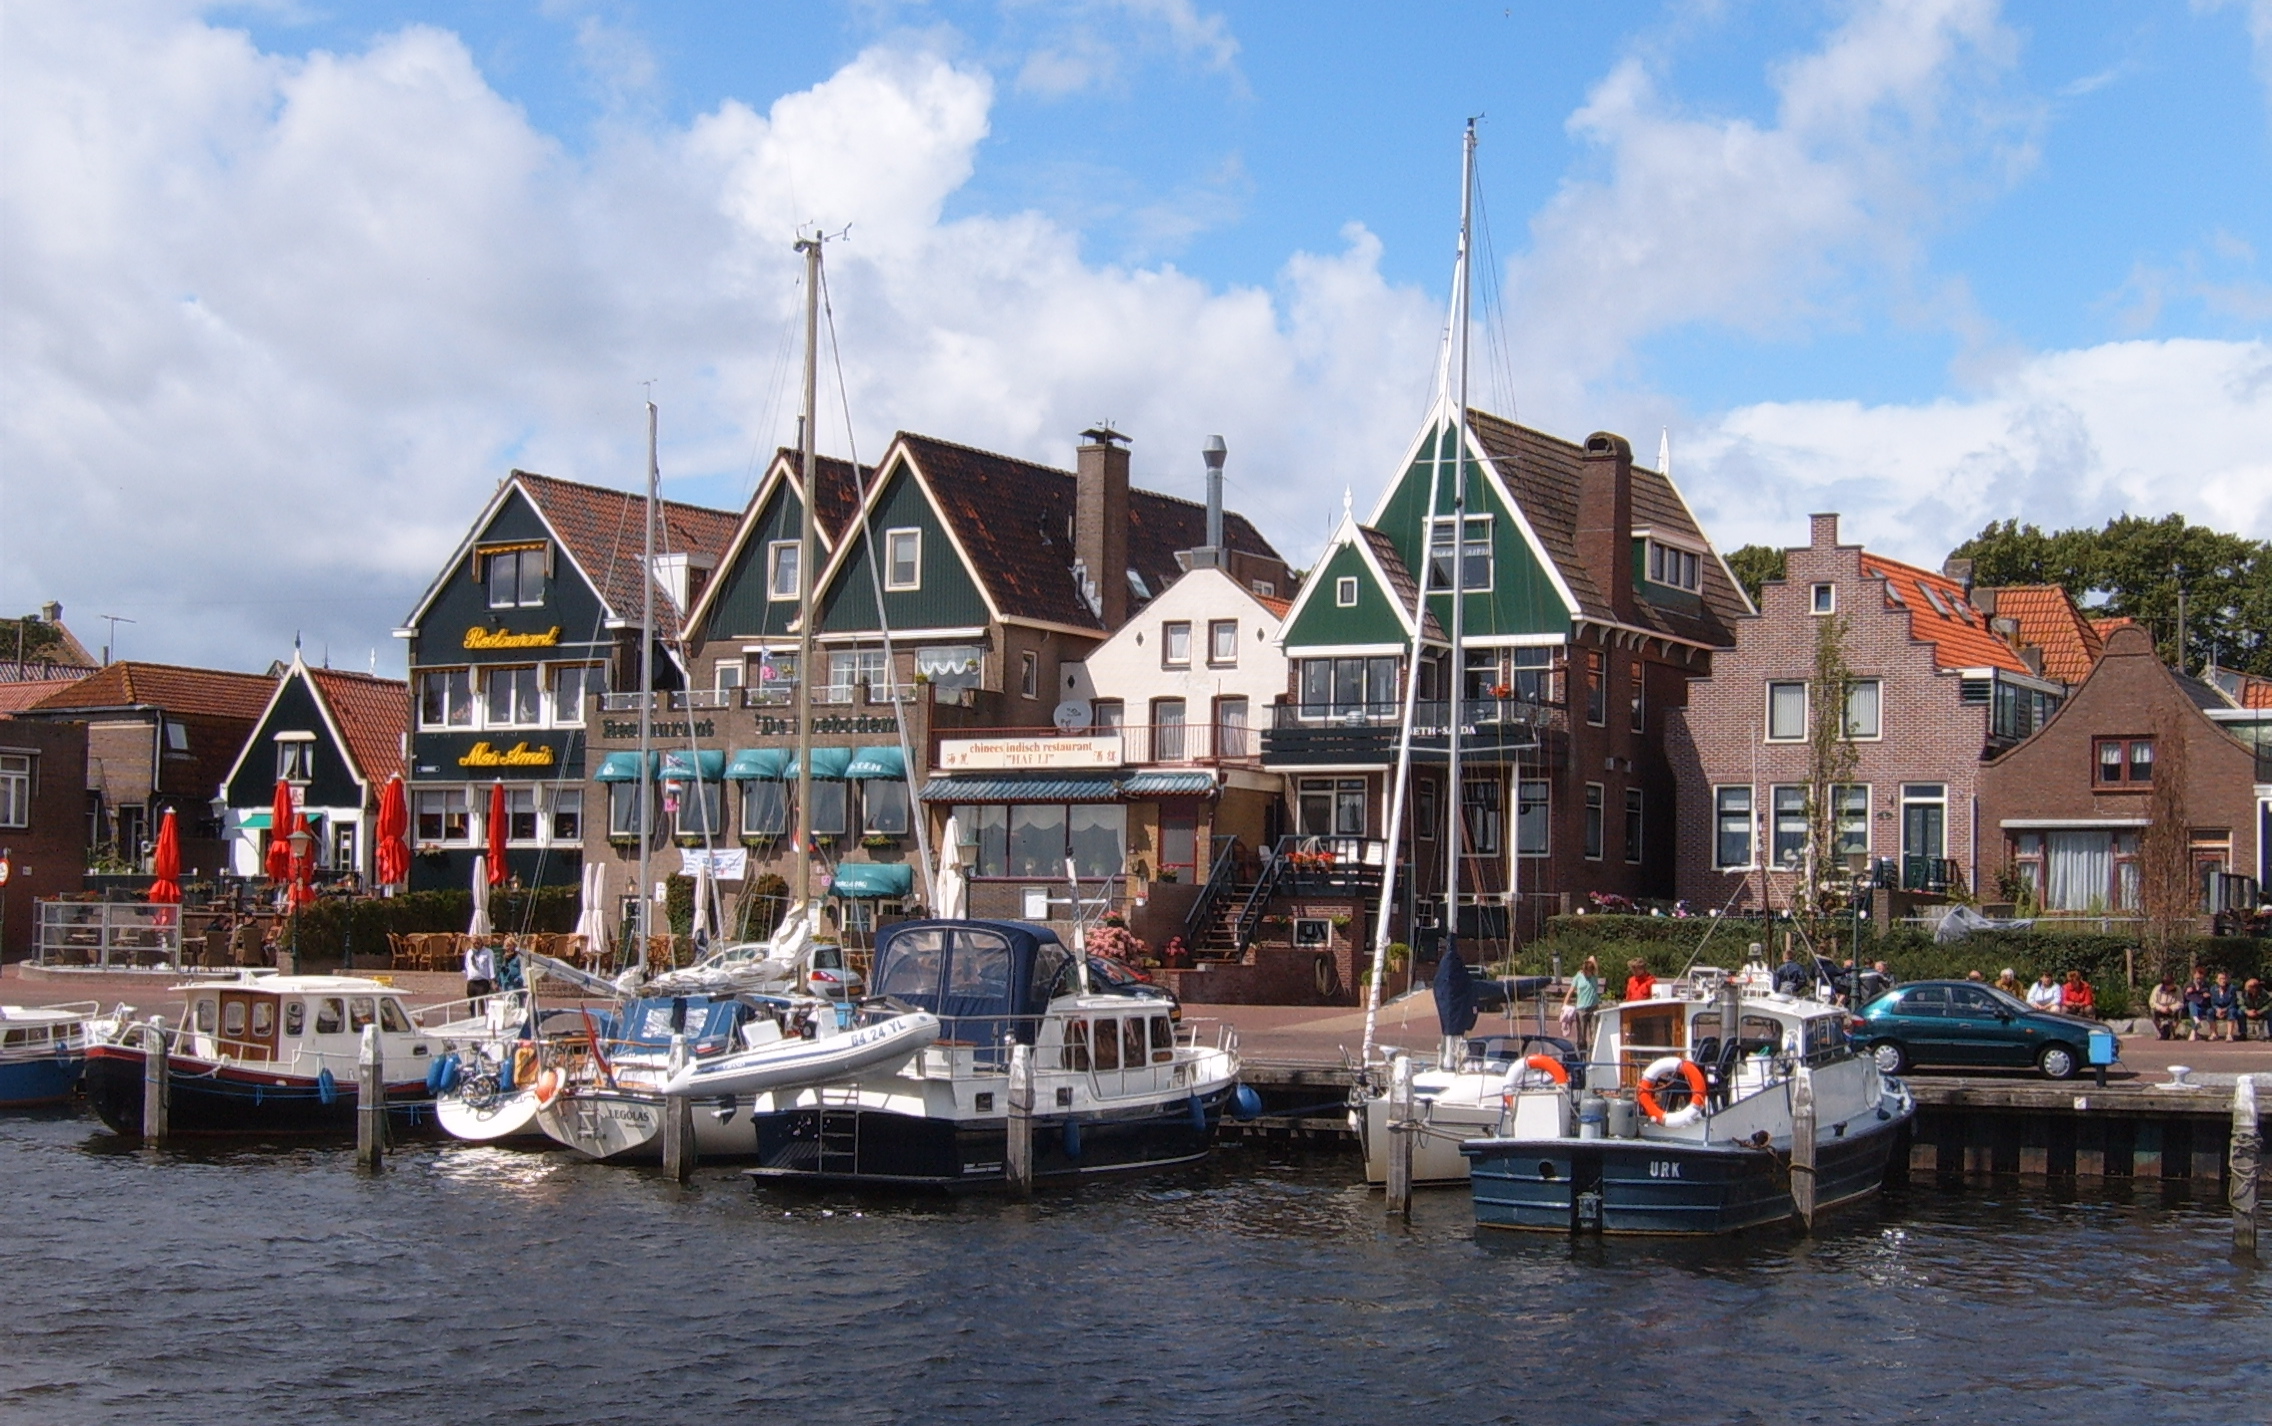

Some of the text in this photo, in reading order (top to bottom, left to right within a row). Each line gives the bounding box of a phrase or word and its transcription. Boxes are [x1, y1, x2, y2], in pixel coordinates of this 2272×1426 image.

[970, 741, 1093, 754] chinees indisch restaurant
[609, 1109, 650, 1122] LEGOLAS
[1650, 1161, 1681, 1178] URK
